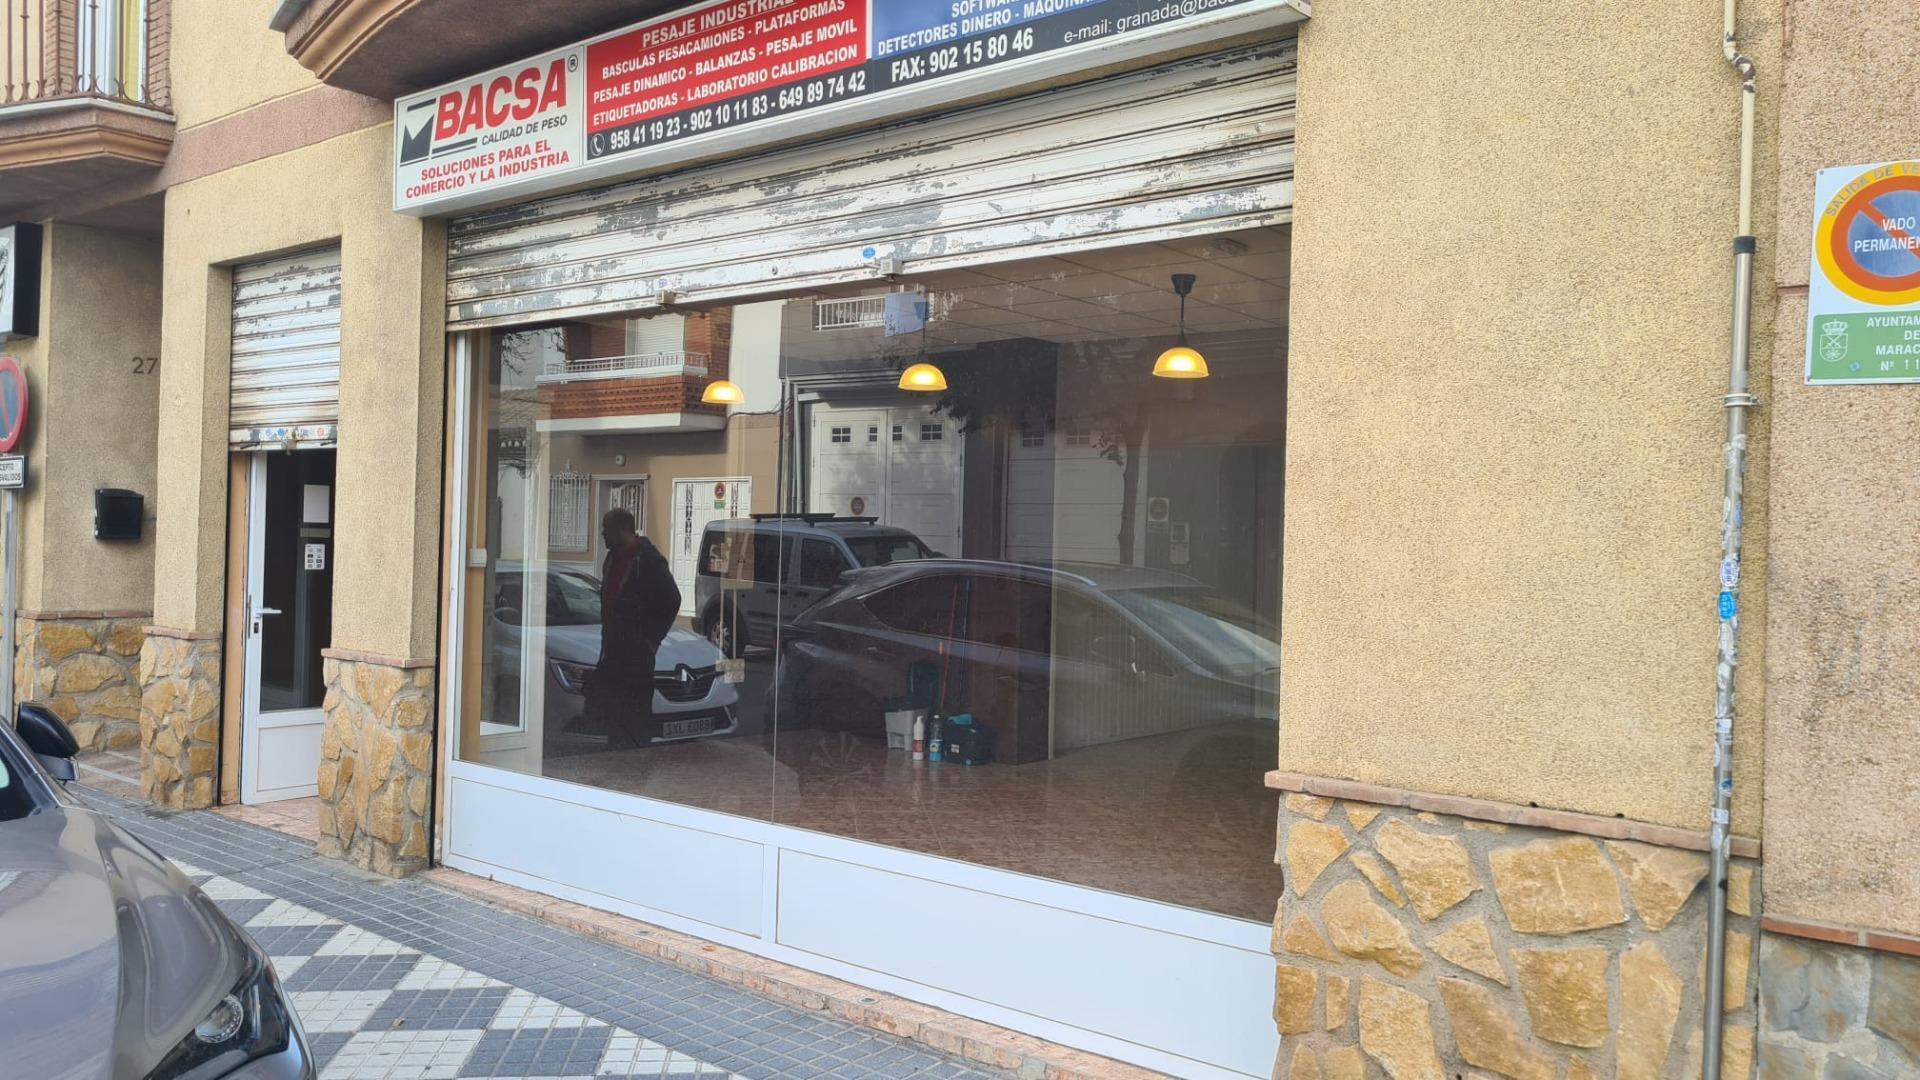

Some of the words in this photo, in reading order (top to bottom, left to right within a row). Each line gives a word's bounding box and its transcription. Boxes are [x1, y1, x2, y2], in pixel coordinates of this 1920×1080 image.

[643, 19, 696, 48] PESAJE
[700, 0, 794, 31] INDUSTRI
[878, 22, 958, 56] DETECTORES
[961, 8, 1012, 35] DINERO
[1023, 0, 1095, 19] MAQUI
[951, 0, 1020, 18] SOFTW
[1064, 19, 1113, 43] e-mail:
[1116, 0, 1235, 34] granada@ba
[593, 82, 631, 104] PESAJE
[634, 67, 687, 93] DINAMICO
[695, 47, 756, 76] BALANZAS
[766, 30, 814, 56] PESAJE
[817, 18, 858, 42] MOVIL
[602, 53, 656, 80] BASCULAS
[658, 27, 745, 63] PESACAMIONES
[755, 0, 846, 35] PLATAFORMAS
[891, 56, 925, 83] FAX:
[930, 49, 958, 74] 902
[963, 40, 983, 65] 15
[988, 34, 1008, 59] 80
[1012, 27, 1034, 52] 46
[593, 92, 678, 126] ETIQUETADORAS
[687, 69, 768, 102] LABORATORIO
[771, 44, 858, 79] CALIBRACION
[481, 126, 523, 146] CALIDAD
[525, 122, 539, 138] DE
[541, 114, 568, 131] PESO
[610, 129, 630, 150] 958
[633, 125, 646, 144] 41
[650, 121, 664, 140] 19
[666, 117, 681, 137] 23
[690, 109, 712, 131] 902
[715, 104, 730, 124] 10
[733, 99, 748, 120] 11
[752, 95, 768, 116] 83
[780, 86, 804, 110] 649
[807, 81, 824, 103] 89
[827, 75, 845, 98] 74
[848, 70, 866, 93] 42
[406, 175, 465, 199] COMERCIO
[469, 172, 477, 185] Y
[480, 168, 495, 182] LA
[500, 150, 570, 178] INDUSTRIA
[421, 153, 495, 181] SOLUCIONES
[499, 144, 532, 163] PARA
[535, 139, 551, 154] EL
[1825, 176, 1867, 217] SALIDA
[1874, 166, 1894, 180] DE
[1882, 216, 1916, 231] VADO
[1876, 344, 1920, 355] MARAC
[1904, 329, 1920, 341] DE
[131, 356, 159, 375] 27
